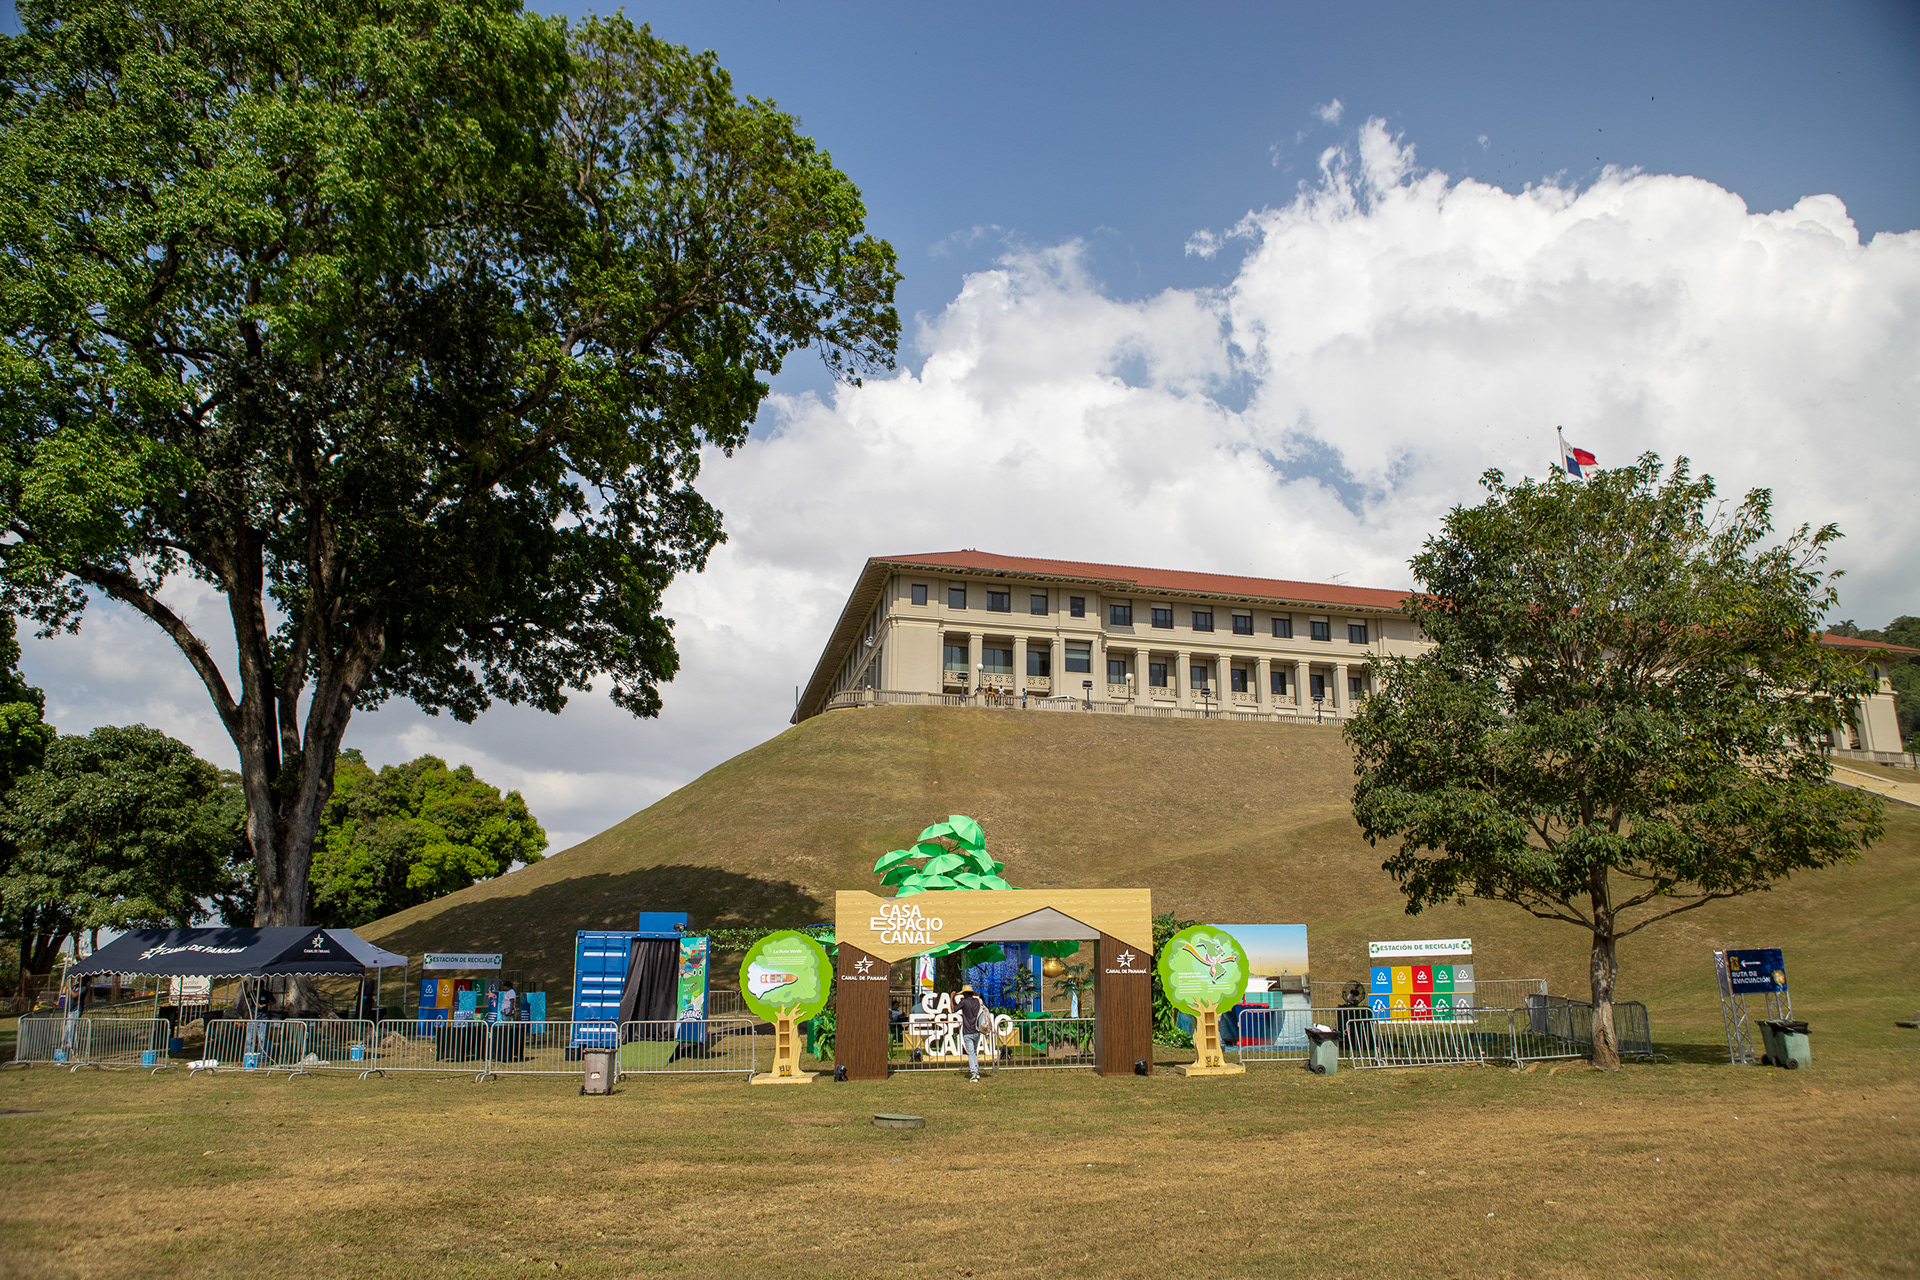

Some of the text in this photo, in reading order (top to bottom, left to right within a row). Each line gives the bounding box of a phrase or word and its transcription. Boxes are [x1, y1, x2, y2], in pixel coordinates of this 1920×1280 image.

[880, 904, 921, 918] CASA
[870, 917, 943, 931] ESPACIO
[880, 930, 935, 945] CANAL
[1732, 976, 1771, 984] EVACUACIÓN
